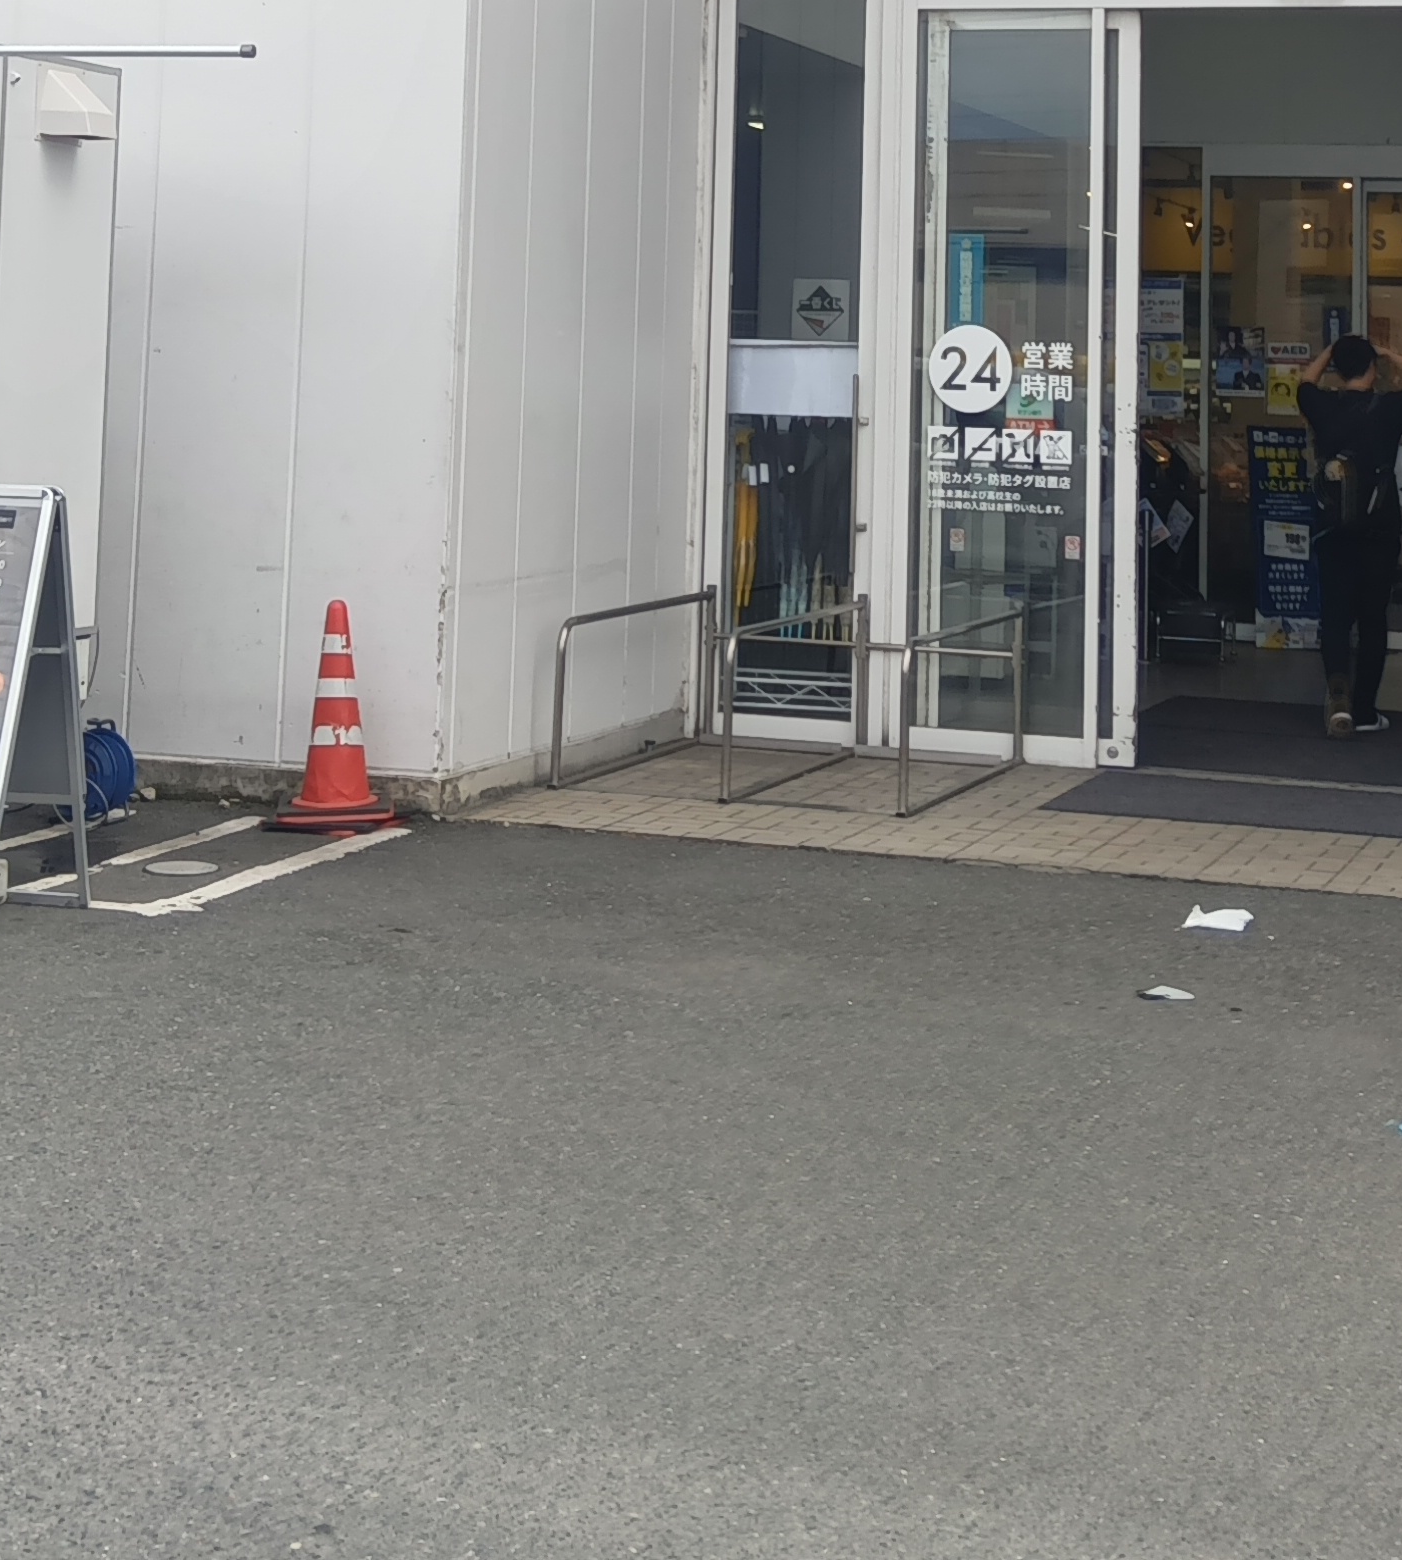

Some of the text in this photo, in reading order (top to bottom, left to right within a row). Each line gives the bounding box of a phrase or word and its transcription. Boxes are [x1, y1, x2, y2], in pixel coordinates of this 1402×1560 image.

[1021, 341, 1074, 370] 営業
[1282, 345, 1308, 355] AED
[939, 345, 1001, 392] 24
[1020, 373, 1073, 402] 時間
